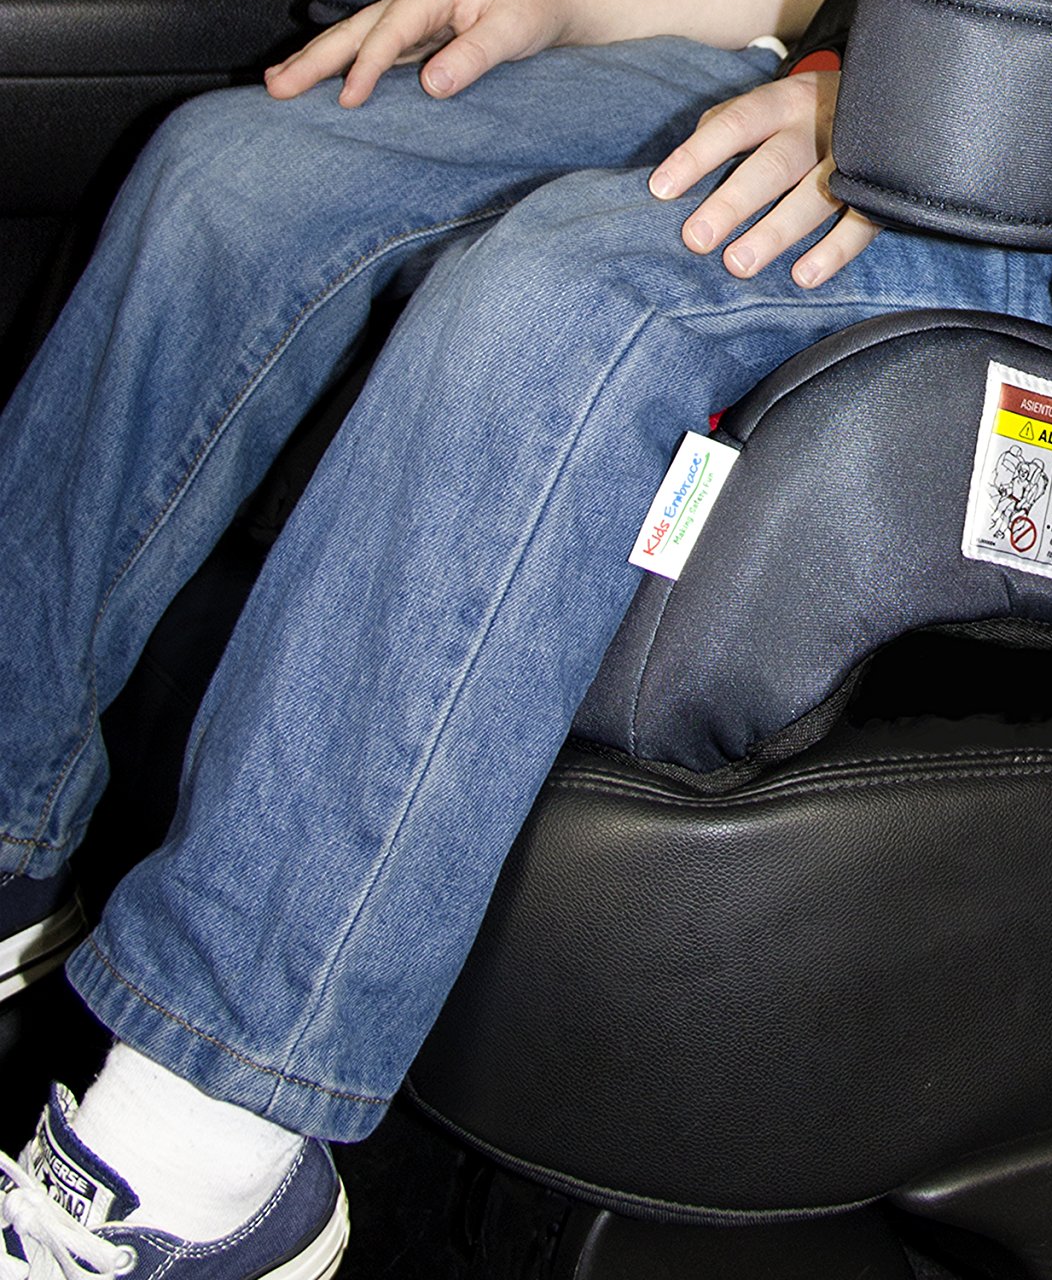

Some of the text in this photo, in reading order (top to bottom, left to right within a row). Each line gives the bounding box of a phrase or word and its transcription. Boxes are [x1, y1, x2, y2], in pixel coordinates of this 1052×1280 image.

[673, 473, 714, 545] Making Safety Fun
